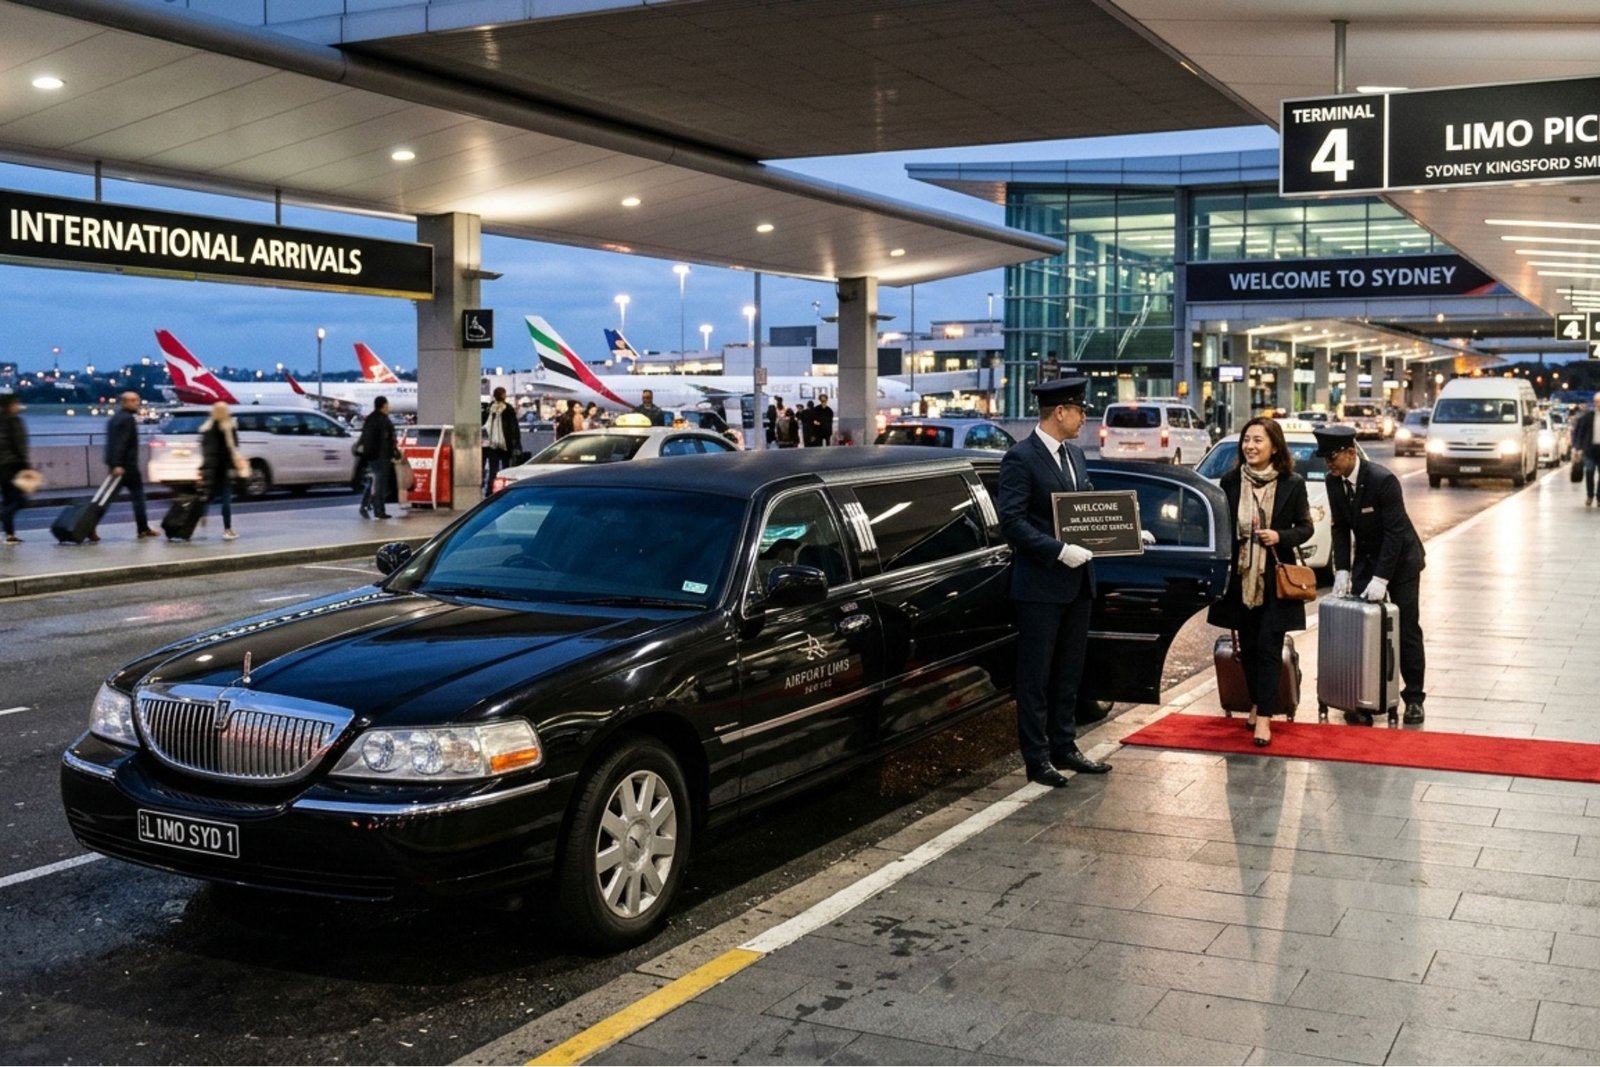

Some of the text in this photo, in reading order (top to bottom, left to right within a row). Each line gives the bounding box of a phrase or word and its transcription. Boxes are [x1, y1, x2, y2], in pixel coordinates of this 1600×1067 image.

[1292, 104, 1375, 123] TERMINAL
[1446, 114, 1600, 151] LIMO PIC
[1310, 128, 1354, 182] 4
[1425, 162, 1482, 178] SYDNEY
[1486, 157, 1570, 174] KINGSFORD
[10, 209, 362, 275] INTERNATIONAL ARRIVALS
[1229, 266, 1456, 291] WELCOME TO SYDNEY
[1562, 320, 1582, 340] 4
[189, 824, 222, 849] SYD
[226, 830, 233, 852] 1
